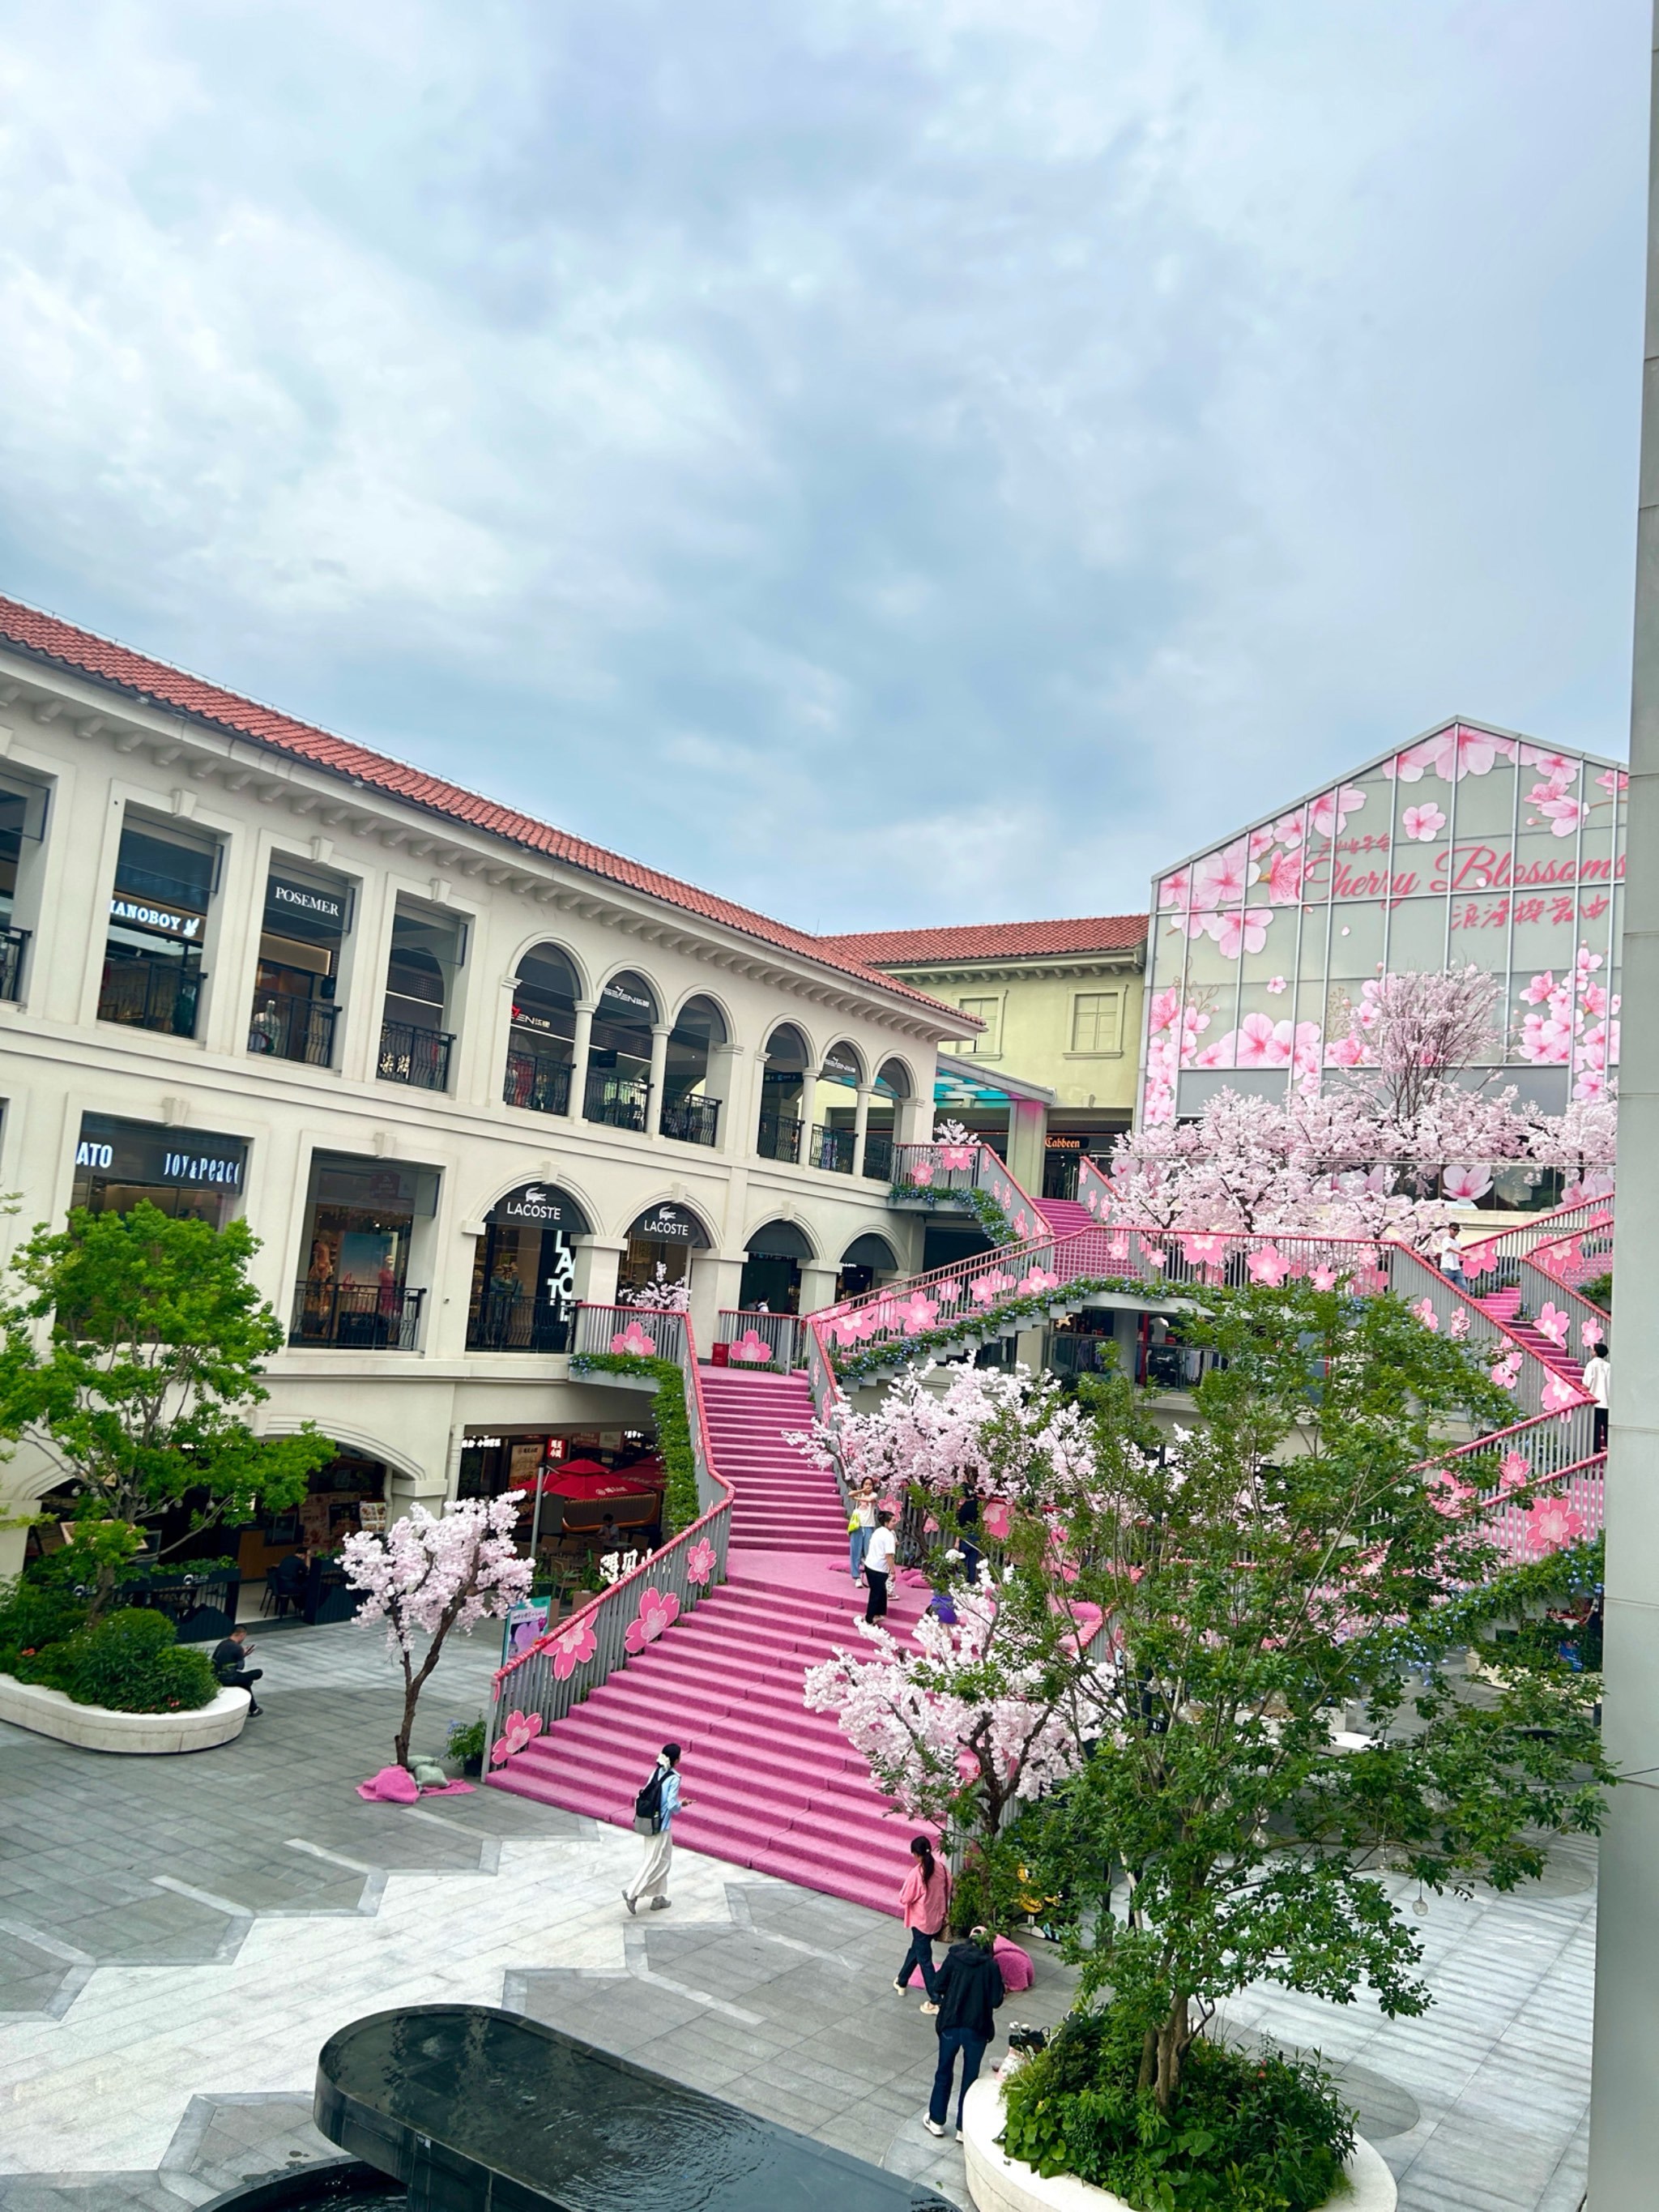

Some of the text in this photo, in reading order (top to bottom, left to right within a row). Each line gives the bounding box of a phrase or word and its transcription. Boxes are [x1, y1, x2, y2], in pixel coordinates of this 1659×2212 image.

[1295, 845, 1627, 910] Cherry Blossoms
[275, 886, 339, 916] POSEMER
[507, 1202, 561, 1220] LACOSTE
[644, 1219, 689, 1236] LACOSTE
